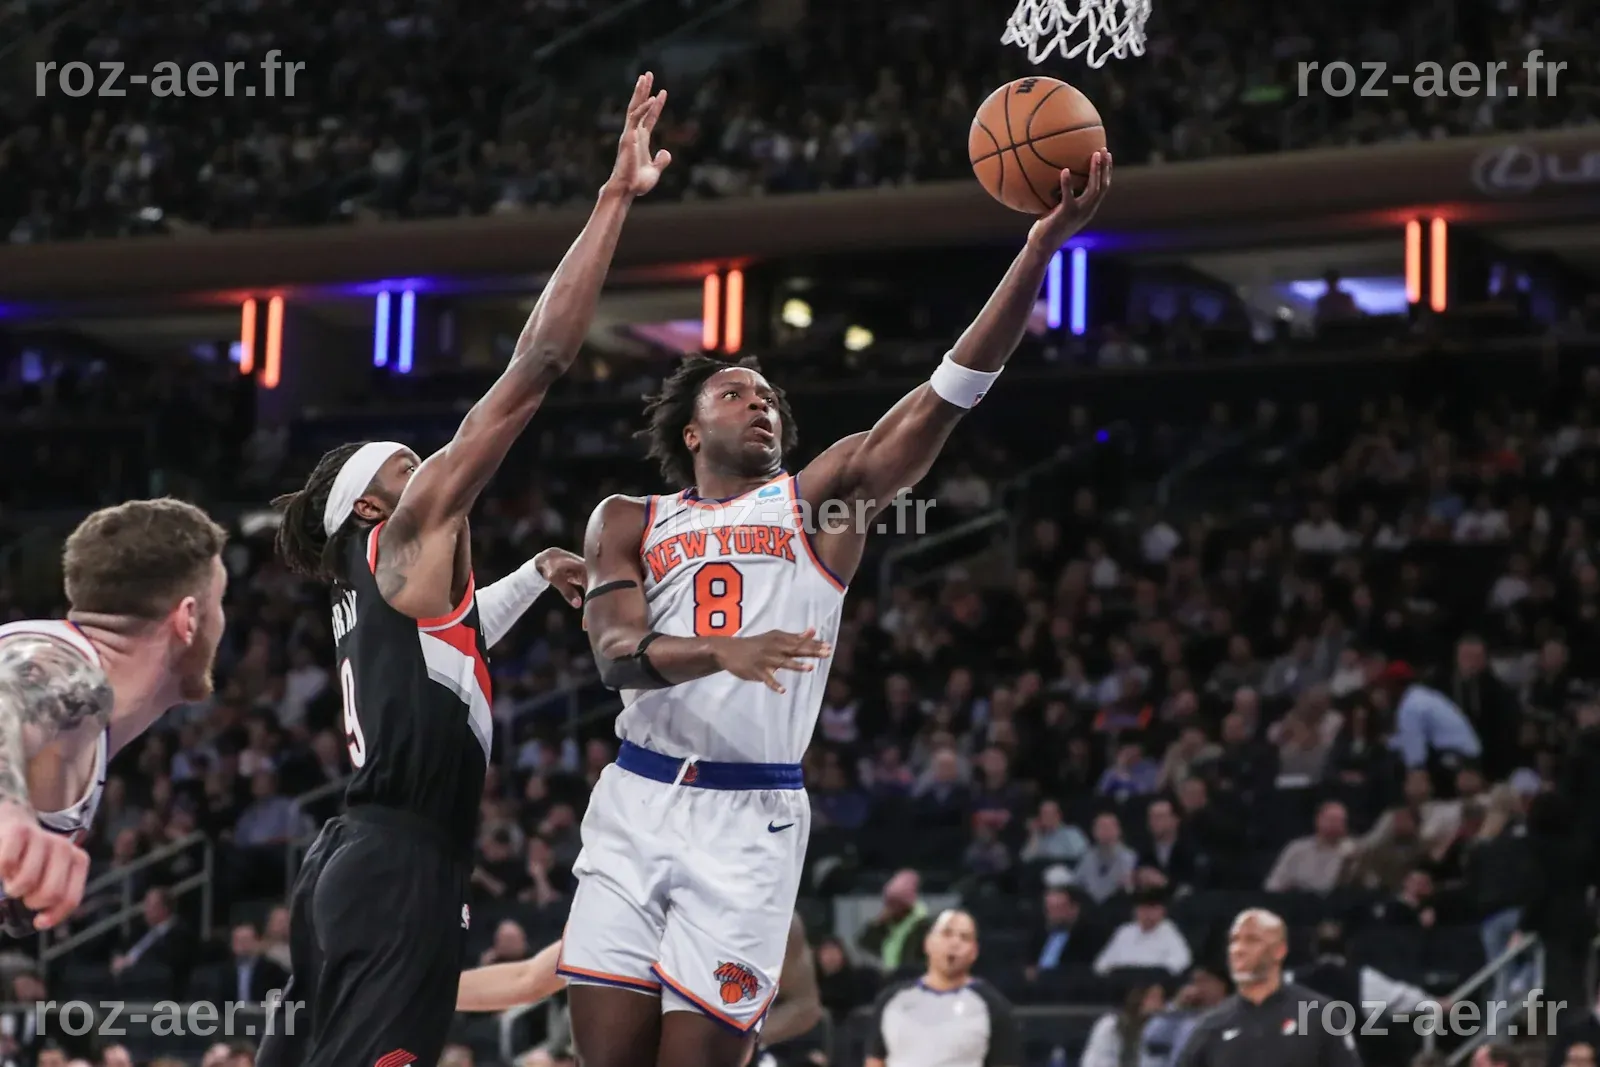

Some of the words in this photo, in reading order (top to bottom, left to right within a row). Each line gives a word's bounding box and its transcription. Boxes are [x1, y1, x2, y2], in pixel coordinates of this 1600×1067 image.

[646, 528, 706, 584] NEW
[715, 524, 797, 564] YORK
[693, 561, 743, 637] 8
[341, 657, 366, 768] 9
